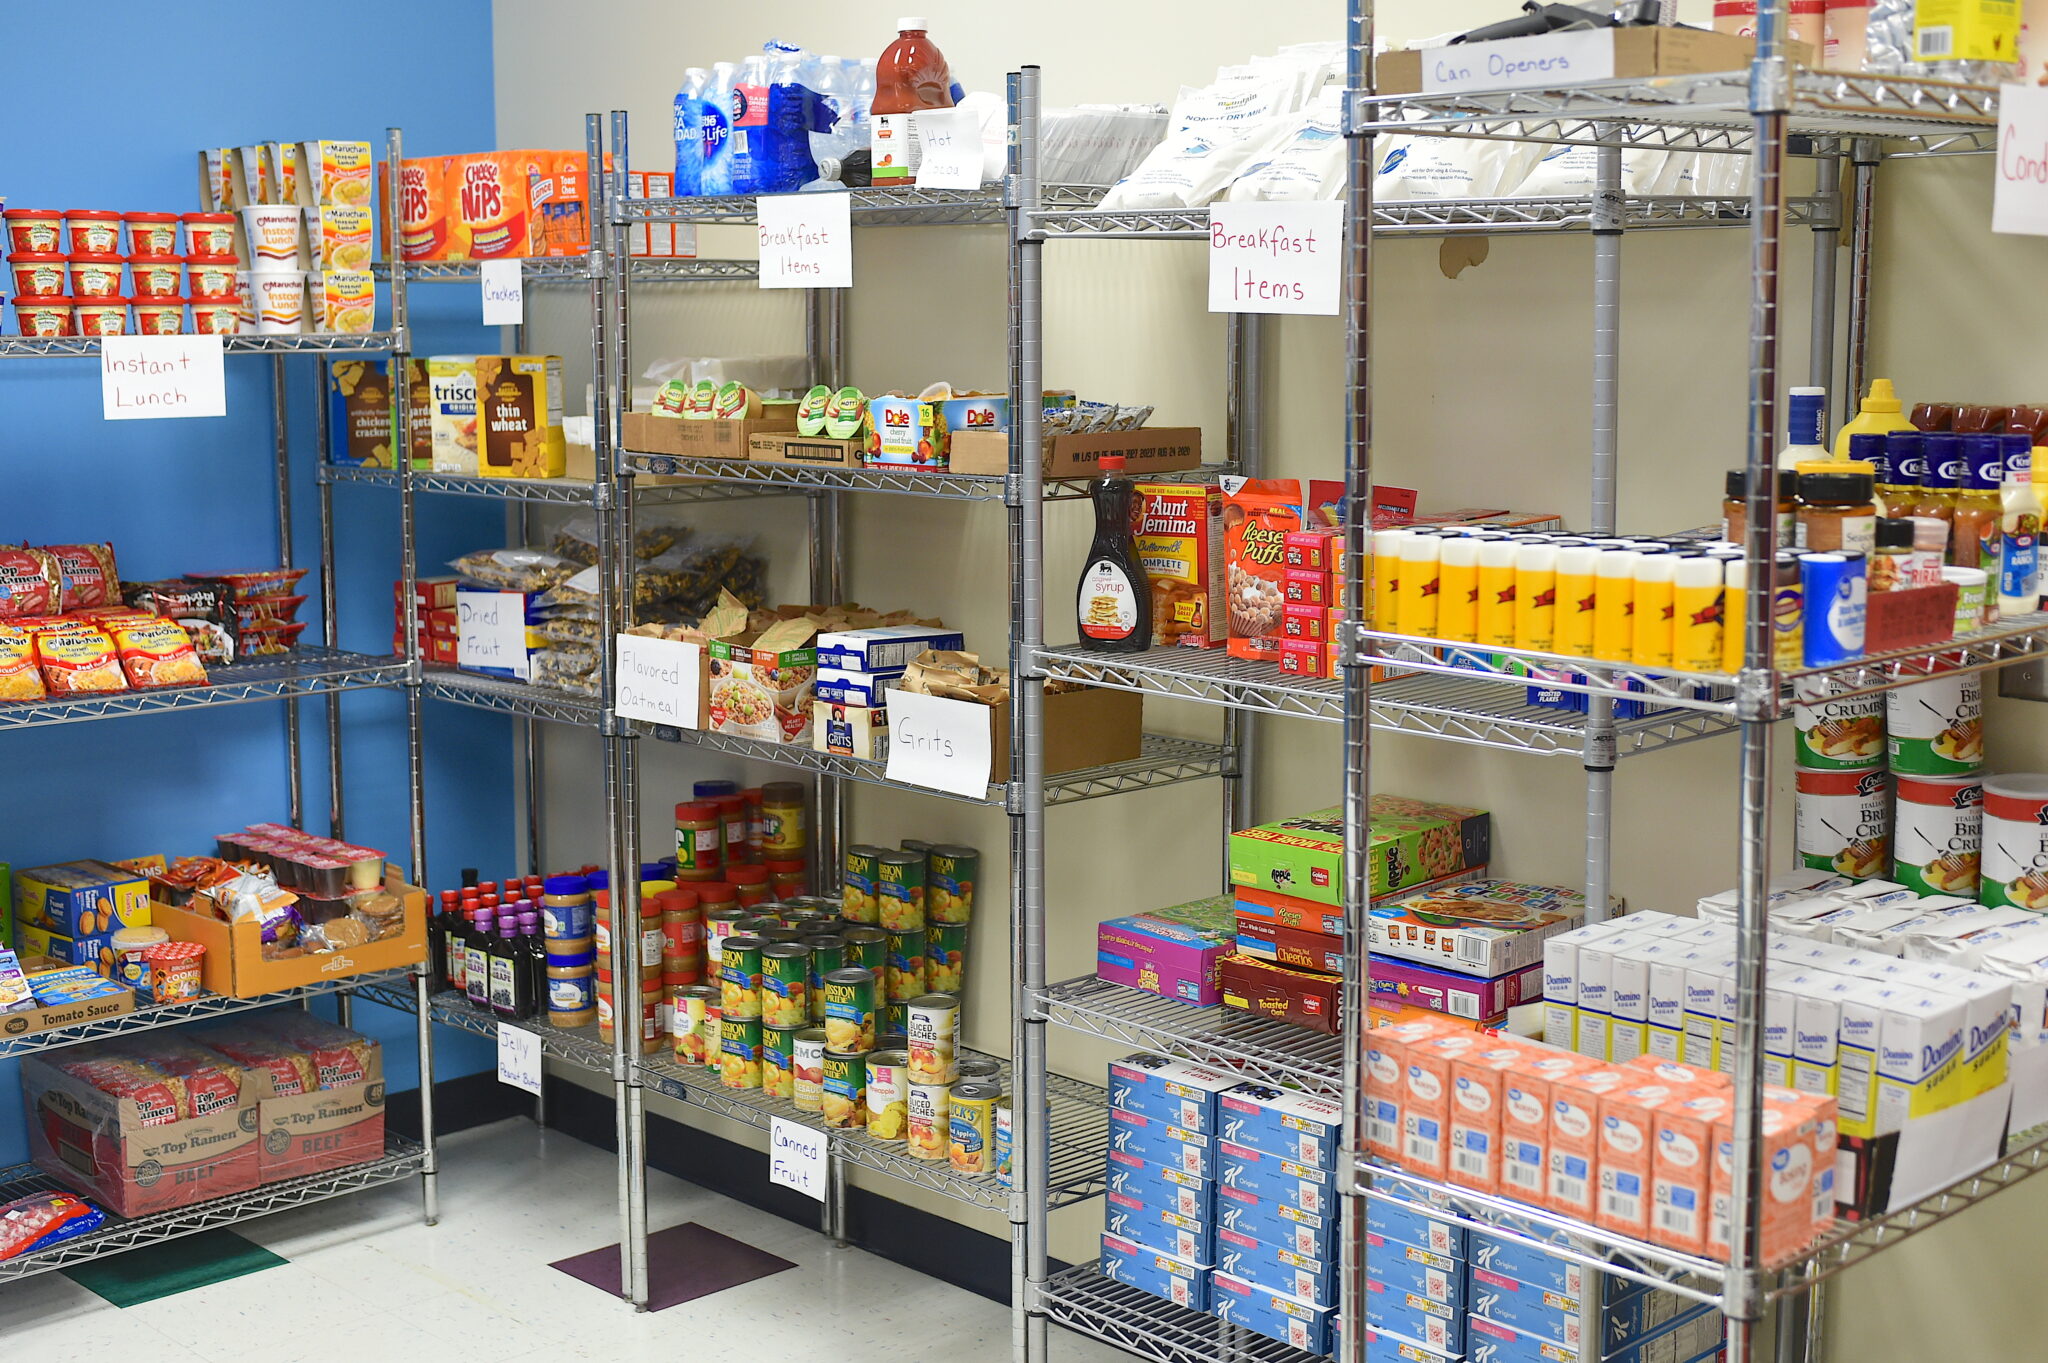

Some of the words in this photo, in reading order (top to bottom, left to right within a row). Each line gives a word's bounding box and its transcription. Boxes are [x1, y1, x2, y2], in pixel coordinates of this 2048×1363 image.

[1436, 60, 1472, 83] Can
[1488, 50, 1569, 78] Openers
[706, 126, 727, 145] Life
[926, 128, 952, 147] Hot
[331, 144, 368, 153] Maruchan
[560, 176, 576, 185] Toast
[532, 180, 553, 200] Lance
[562, 185, 576, 195] Chee
[332, 210, 368, 218] Maruchan
[262, 228, 296, 236] Instant
[759, 224, 829, 251] Breakfast
[1210, 221, 1318, 257] Breakfast
[266, 236, 293, 244] Lunch
[781, 256, 821, 276] Items
[334, 275, 370, 283] Maruchan
[1234, 266, 1304, 301] Items
[484, 278, 521, 303] Crackers
[272, 300, 298, 309] Lunch
[105, 349, 190, 374] Instant
[116, 387, 188, 408] Lunch
[435, 384, 477, 401] trisc
[496, 404, 520, 418] thin
[885, 409, 910, 425] Dole
[921, 408, 930, 418] 16
[967, 408, 996, 426] Dole
[491, 416, 528, 432] wheat
[884, 435, 900, 444] mixed
[900, 435, 912, 444] fruit
[890, 428, 907, 438] cherry
[1178, 446, 1190, 456] 2020
[1150, 496, 1188, 517] Aunt
[1134, 512, 1197, 536] Jemima
[1242, 520, 1286, 543] Reese'
[1138, 539, 1182, 554] Buttermilk
[1241, 541, 1284, 565] Puffs
[1144, 558, 1182, 570] OMPLETE
[74, 576, 94, 584] BEEF
[1095, 582, 1125, 594] syrup
[460, 600, 499, 627] Dried
[467, 636, 500, 656] Fruit
[77, 662, 94, 670] Beef
[623, 650, 680, 685] Flavored
[1537, 690, 1562, 698] FROSTED
[1538, 696, 1560, 704] FLAKES
[1960, 688, 1980, 702] BRE
[620, 686, 678, 718] Oatmeal
[1824, 702, 1883, 718] CRUMBS
[1956, 704, 1980, 718] CRU
[828, 734, 852, 748] GRITS
[898, 716, 954, 758] Grits
[1860, 809, 1886, 822] BRE
[1856, 824, 1886, 838] CRU
[1954, 822, 1982, 836] BRE
[1276, 835, 1320, 850] MORE
[1948, 838, 1981, 850] CRU
[1312, 872, 1328, 880] Golden
[1278, 948, 1314, 967] Cheerios
[1140, 968, 1159, 981] Lucky
[1546, 974, 1572, 984] Domino
[1138, 978, 1160, 994] Charms
[1580, 982, 1607, 994] Domino
[1688, 986, 1715, 998] Domino
[1303, 998, 1320, 1006] Golden
[1614, 990, 1641, 1002] Domino
[1651, 998, 1678, 1009] Domino
[1258, 998, 1289, 1010] Toasted
[42, 1010, 84, 1026] Tomato
[86, 1002, 120, 1017] Sauce
[1270, 1008, 1285, 1017] Oats
[910, 1022, 933, 1032] SLICED
[1764, 1025, 1788, 1035] omino
[1844, 1016, 1874, 1029] Domino
[1798, 1031, 1828, 1044] Domino
[1970, 1008, 2008, 1054] Domino
[501, 1032, 529, 1060] Jelly
[1882, 1047, 1914, 1060] Domino
[1922, 1028, 1963, 1073] Domino
[320, 1065, 340, 1076] Top
[320, 1070, 362, 1084] Ramen
[500, 1062, 520, 1082] Peanut
[1191, 1072, 1214, 1082] KEEP
[196, 1091, 215, 1104] Top
[197, 1094, 237, 1115] Ramen
[910, 1096, 930, 1108] SLICED
[1114, 1086, 1132, 1109] K
[140, 1106, 174, 1119] amen
[290, 1113, 316, 1124] Top
[318, 1105, 364, 1118] Ramen
[1306, 1105, 1333, 1114] KEEP
[956, 1130, 976, 1138] Apples
[1225, 1120, 1244, 1142] K
[161, 1142, 188, 1154] Top
[190, 1131, 238, 1147] Ramen
[302, 1134, 345, 1154] BEEF
[773, 1125, 818, 1161] Canned
[1114, 1130, 1133, 1152] K
[175, 1167, 215, 1185] BEEF
[774, 1161, 810, 1188] Fruit
[1224, 1166, 1244, 1188] K
[1112, 1172, 1130, 1194] K
[1110, 1213, 1128, 1234] K
[1223, 1208, 1244, 1230] K
[1222, 1252, 1242, 1275] K
[1477, 1246, 1500, 1270] K
[1494, 1258, 1518, 1272] Original
[1106, 1258, 1124, 1280] K
[1217, 1299, 1236, 1321] K
[1476, 1294, 1500, 1318] K
[1494, 1306, 1518, 1321] Original
